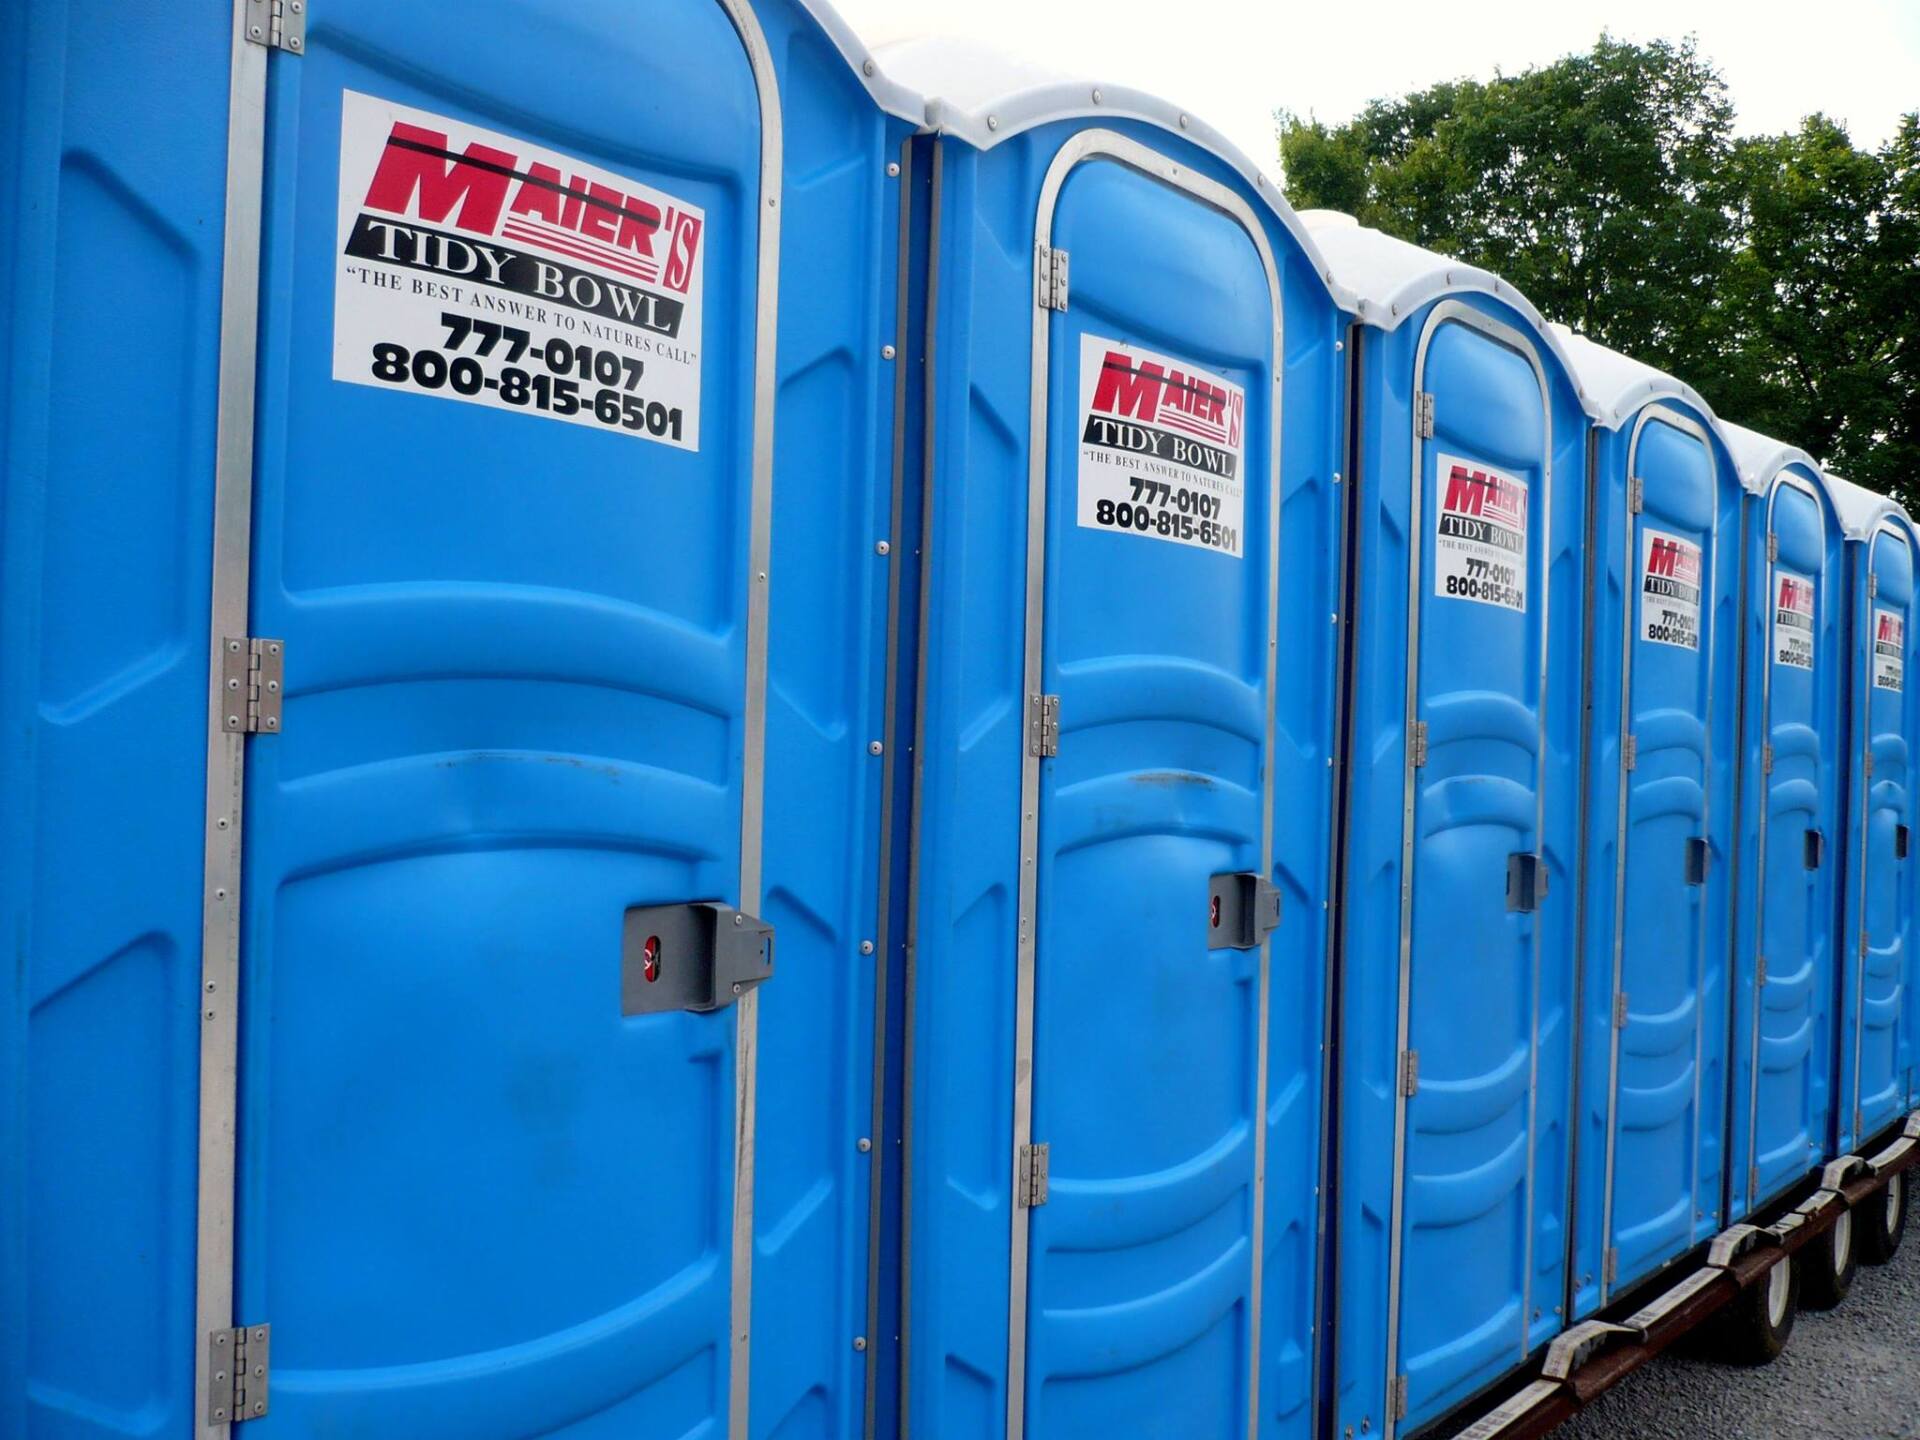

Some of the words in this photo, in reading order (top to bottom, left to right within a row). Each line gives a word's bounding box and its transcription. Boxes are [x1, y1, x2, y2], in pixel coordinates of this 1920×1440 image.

[363, 120, 702, 294] MAIER'S
[367, 221, 517, 285] TIDY
[534, 260, 672, 332] BOWL
[412, 279, 463, 304] BEST
[470, 292, 546, 324] ANSWER
[554, 312, 576, 332] TO
[582, 319, 652, 354] NATURES
[441, 312, 645, 392] 777-0107
[371, 342, 684, 442] 800-815-6501
[1091, 351, 1243, 449] MAIER'S
[1093, 418, 1165, 455] TIDY
[1173, 438, 1234, 478] BOWL
[1115, 454, 1141, 470] BEST
[1144, 462, 1179, 479] ANSWER
[1181, 470, 1191, 483] TO
[1096, 499, 1237, 552] 800-815-6501
[1130, 477, 1221, 520] 777-0107
[1444, 517, 1487, 541] TIDY
[1466, 558, 1516, 587] 777-0107
[1648, 624, 1698, 648] 800-815-
